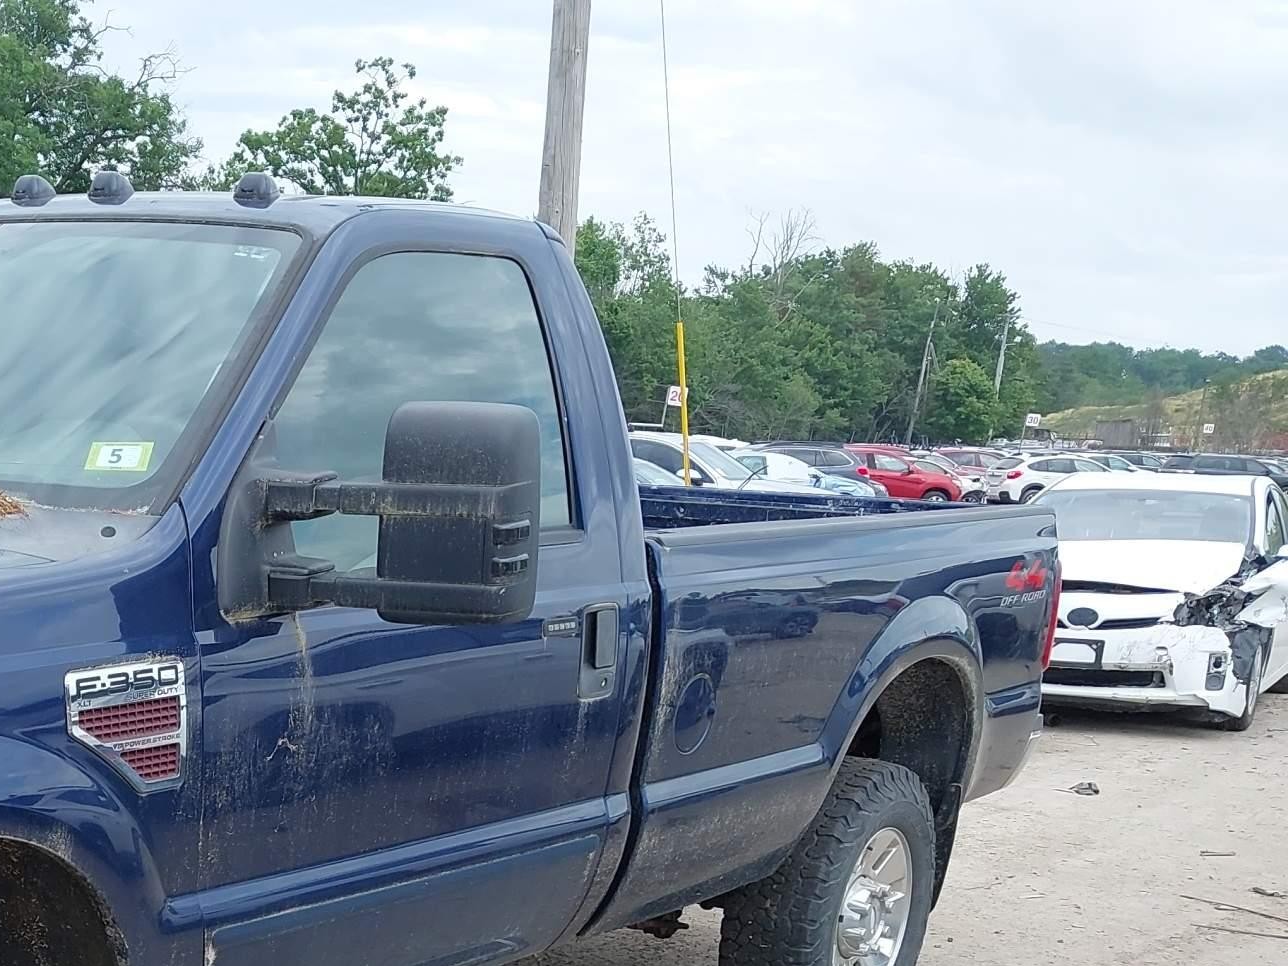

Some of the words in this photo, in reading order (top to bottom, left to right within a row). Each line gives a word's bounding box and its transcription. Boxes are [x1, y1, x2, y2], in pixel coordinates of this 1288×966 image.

[1027, 416, 1039, 425] 30
[108, 448, 124, 464] 5
[1000, 595, 1020, 607] OFF
[1021, 590, 1046, 602] ROAD
[129, 691, 156, 700] SUPER
[157, 687, 179, 696] DUTY
